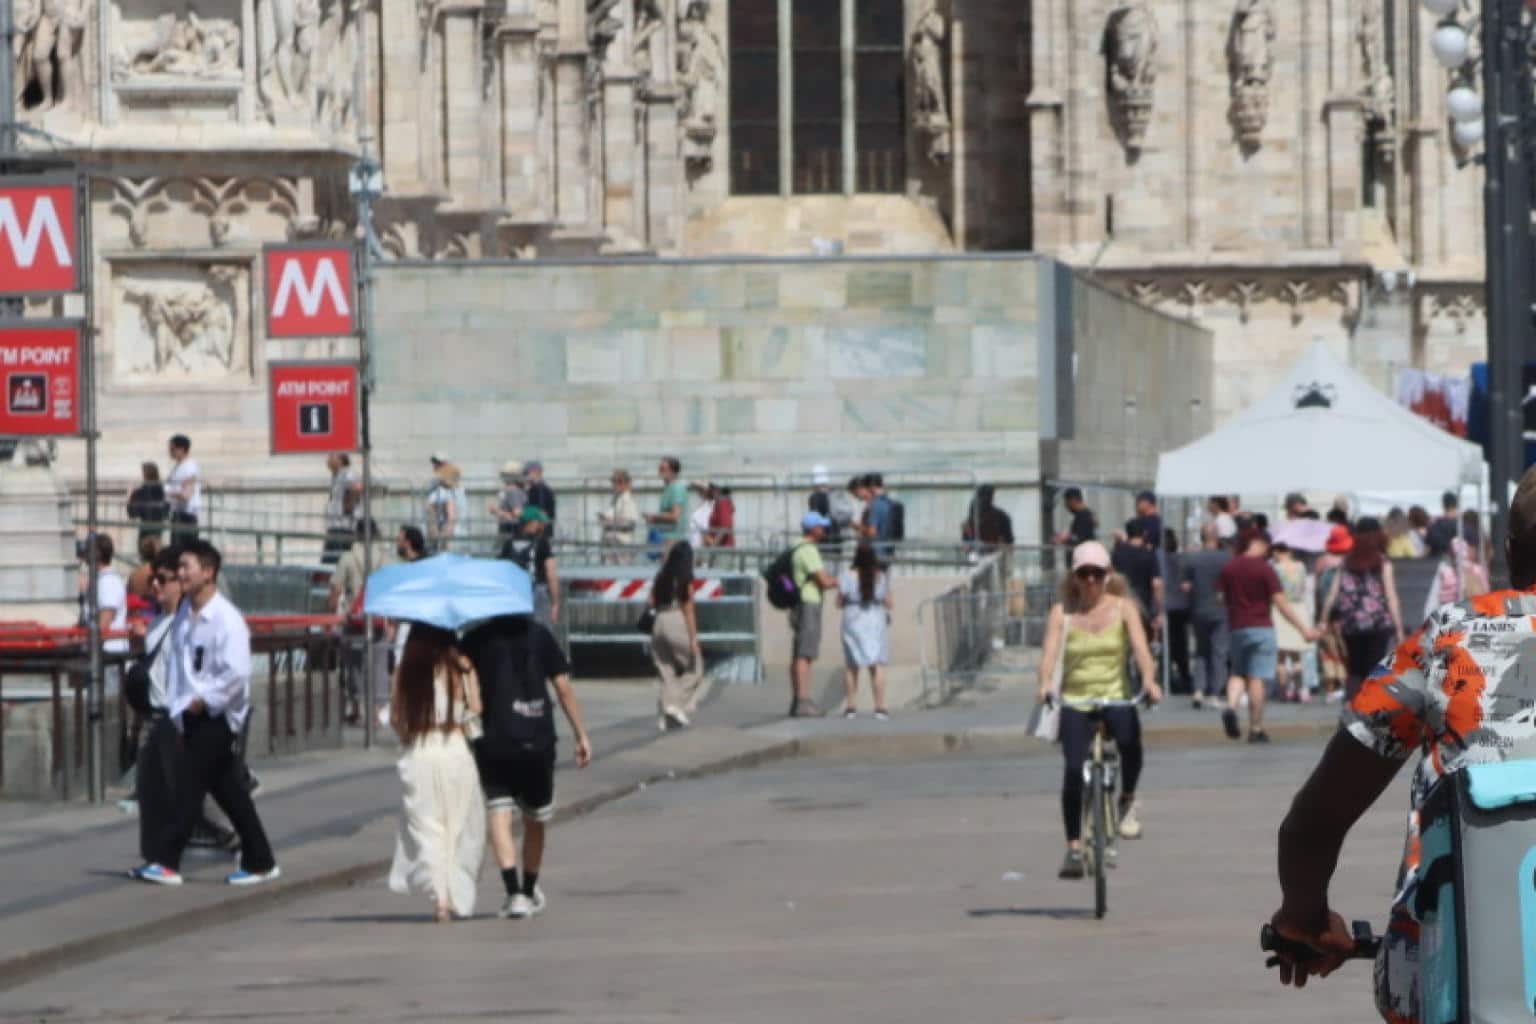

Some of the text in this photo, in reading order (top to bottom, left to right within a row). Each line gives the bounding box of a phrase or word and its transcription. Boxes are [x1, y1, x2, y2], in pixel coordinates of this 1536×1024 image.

[0, 196, 72, 268] M
[271, 258, 349, 318] M
[20, 346, 71, 366] POINT
[277, 380, 350, 396] ATM POINT
